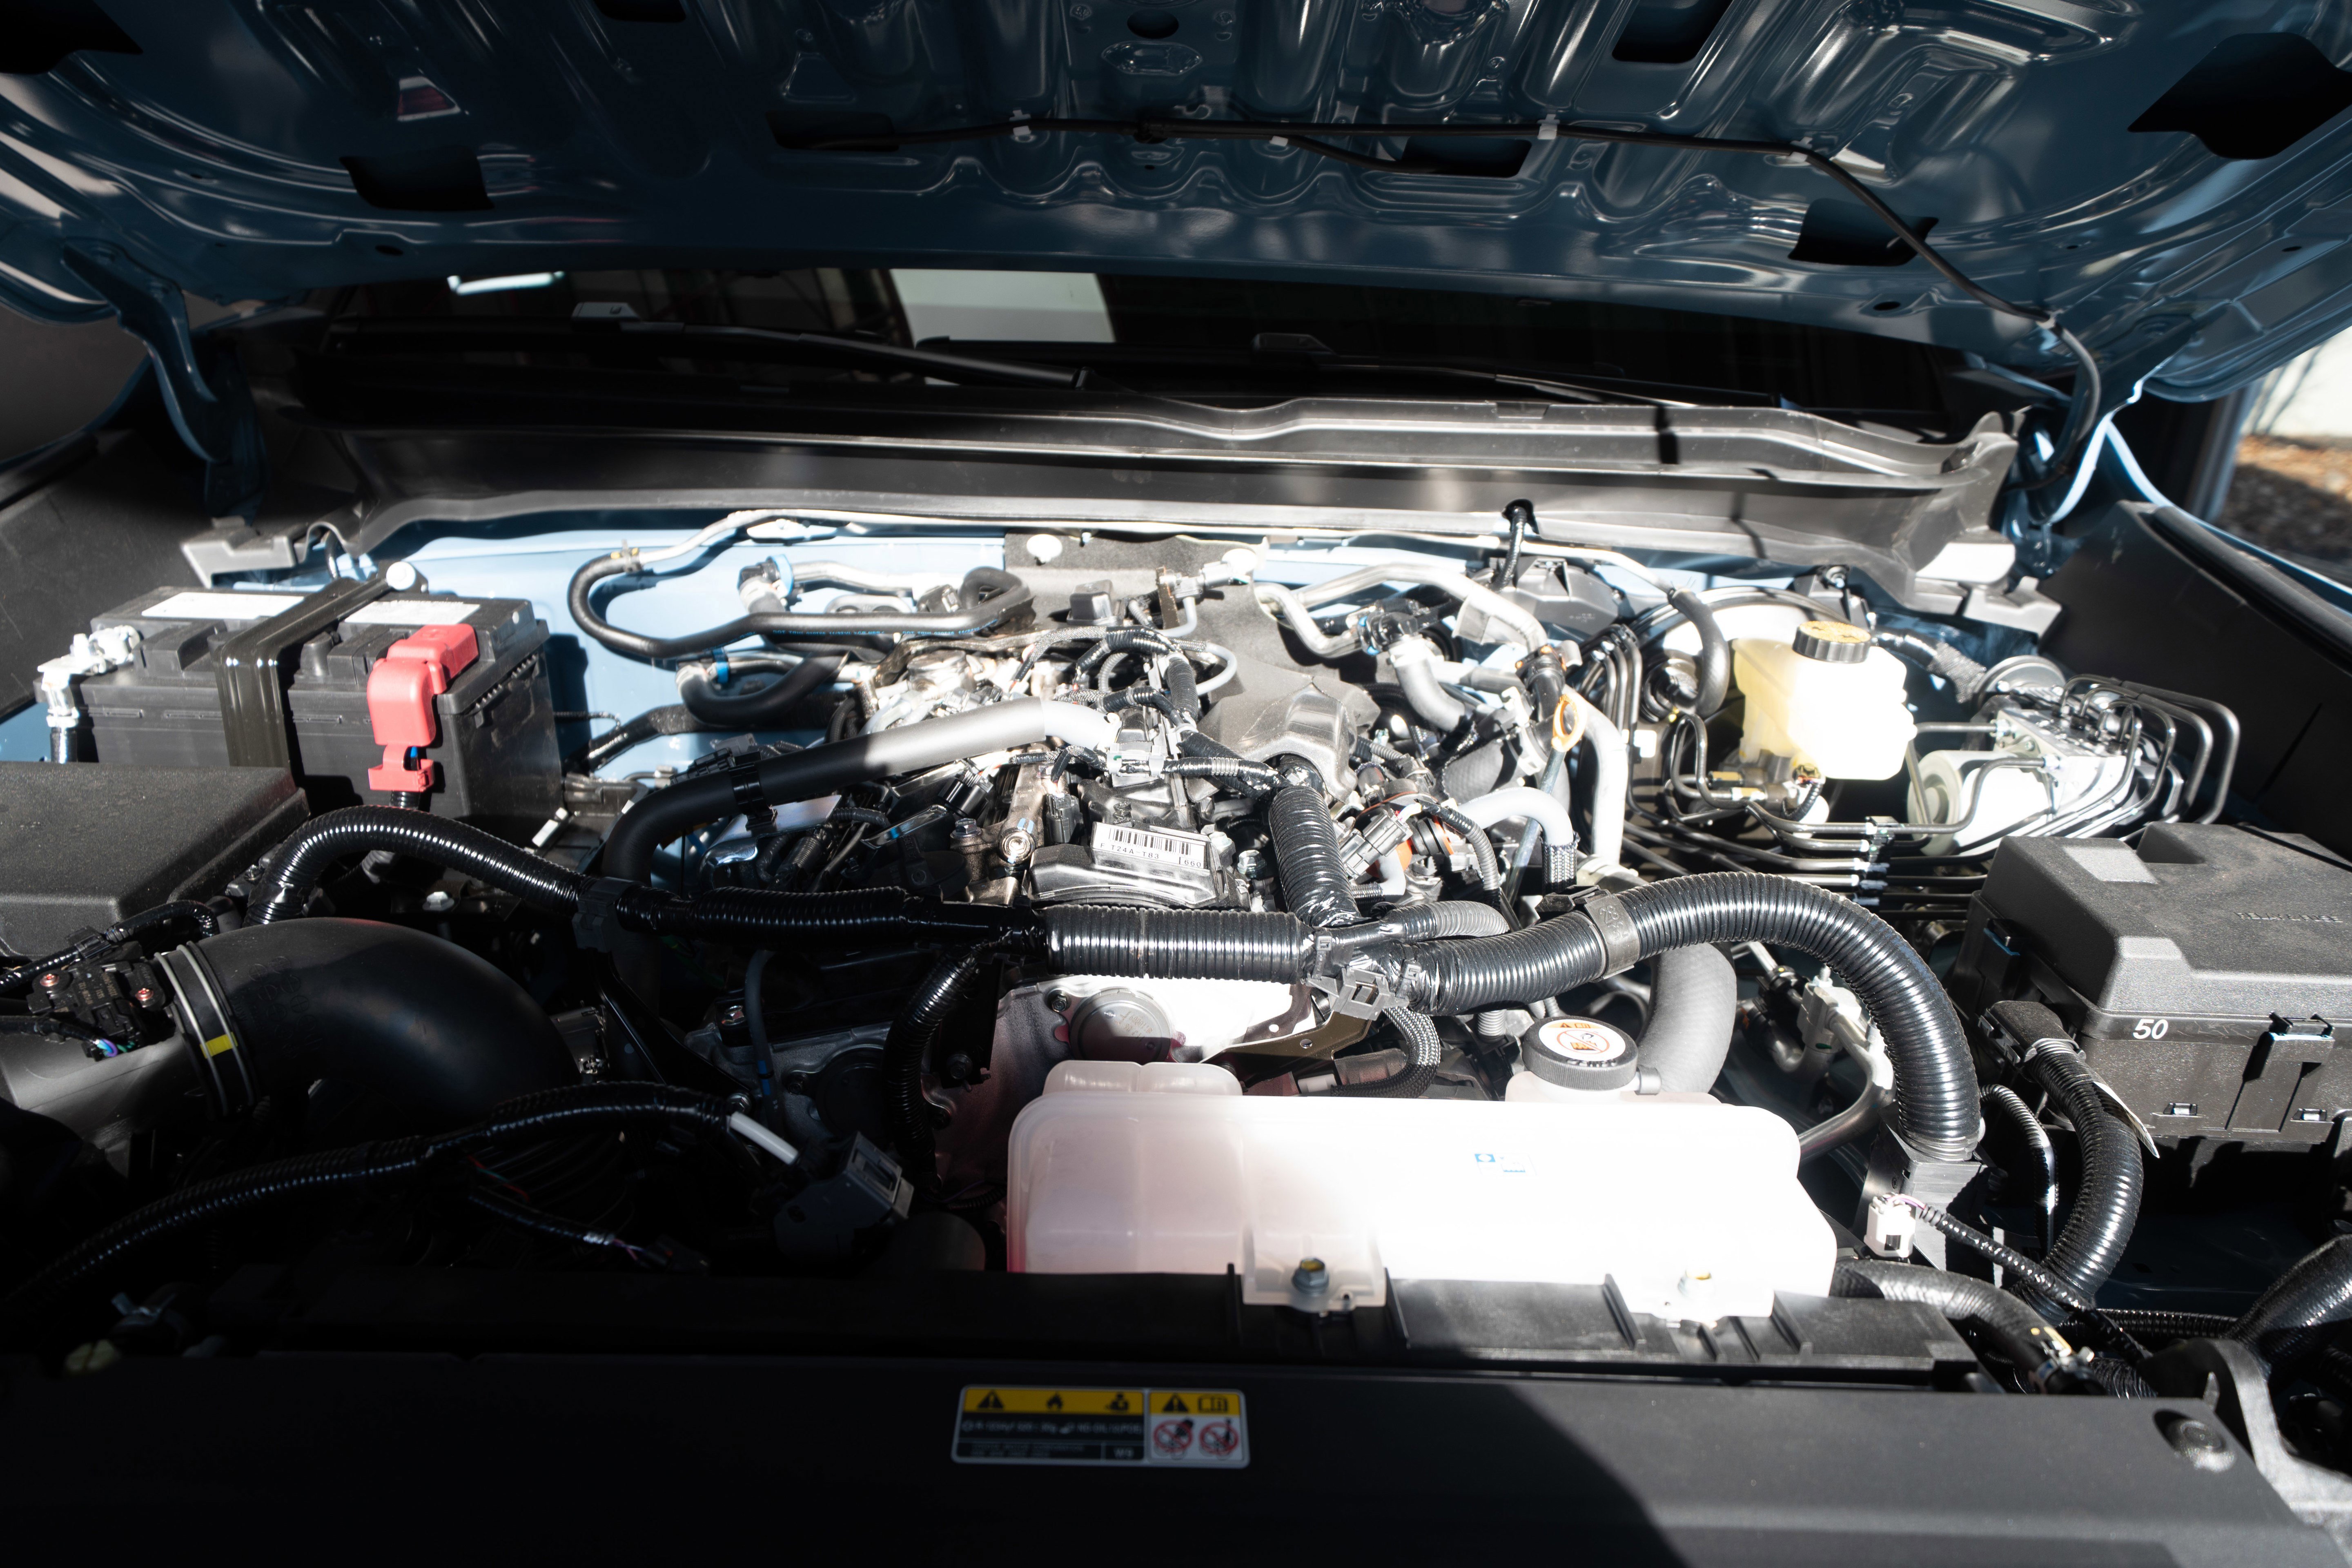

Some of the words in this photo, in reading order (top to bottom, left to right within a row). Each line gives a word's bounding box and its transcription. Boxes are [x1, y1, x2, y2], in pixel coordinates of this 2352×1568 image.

[1111, 844, 1160, 859] T24A-T83
[1185, 859, 1201, 868] 660
[1599, 904, 1619, 924] 28
[2133, 1018, 2169, 1040] 50
